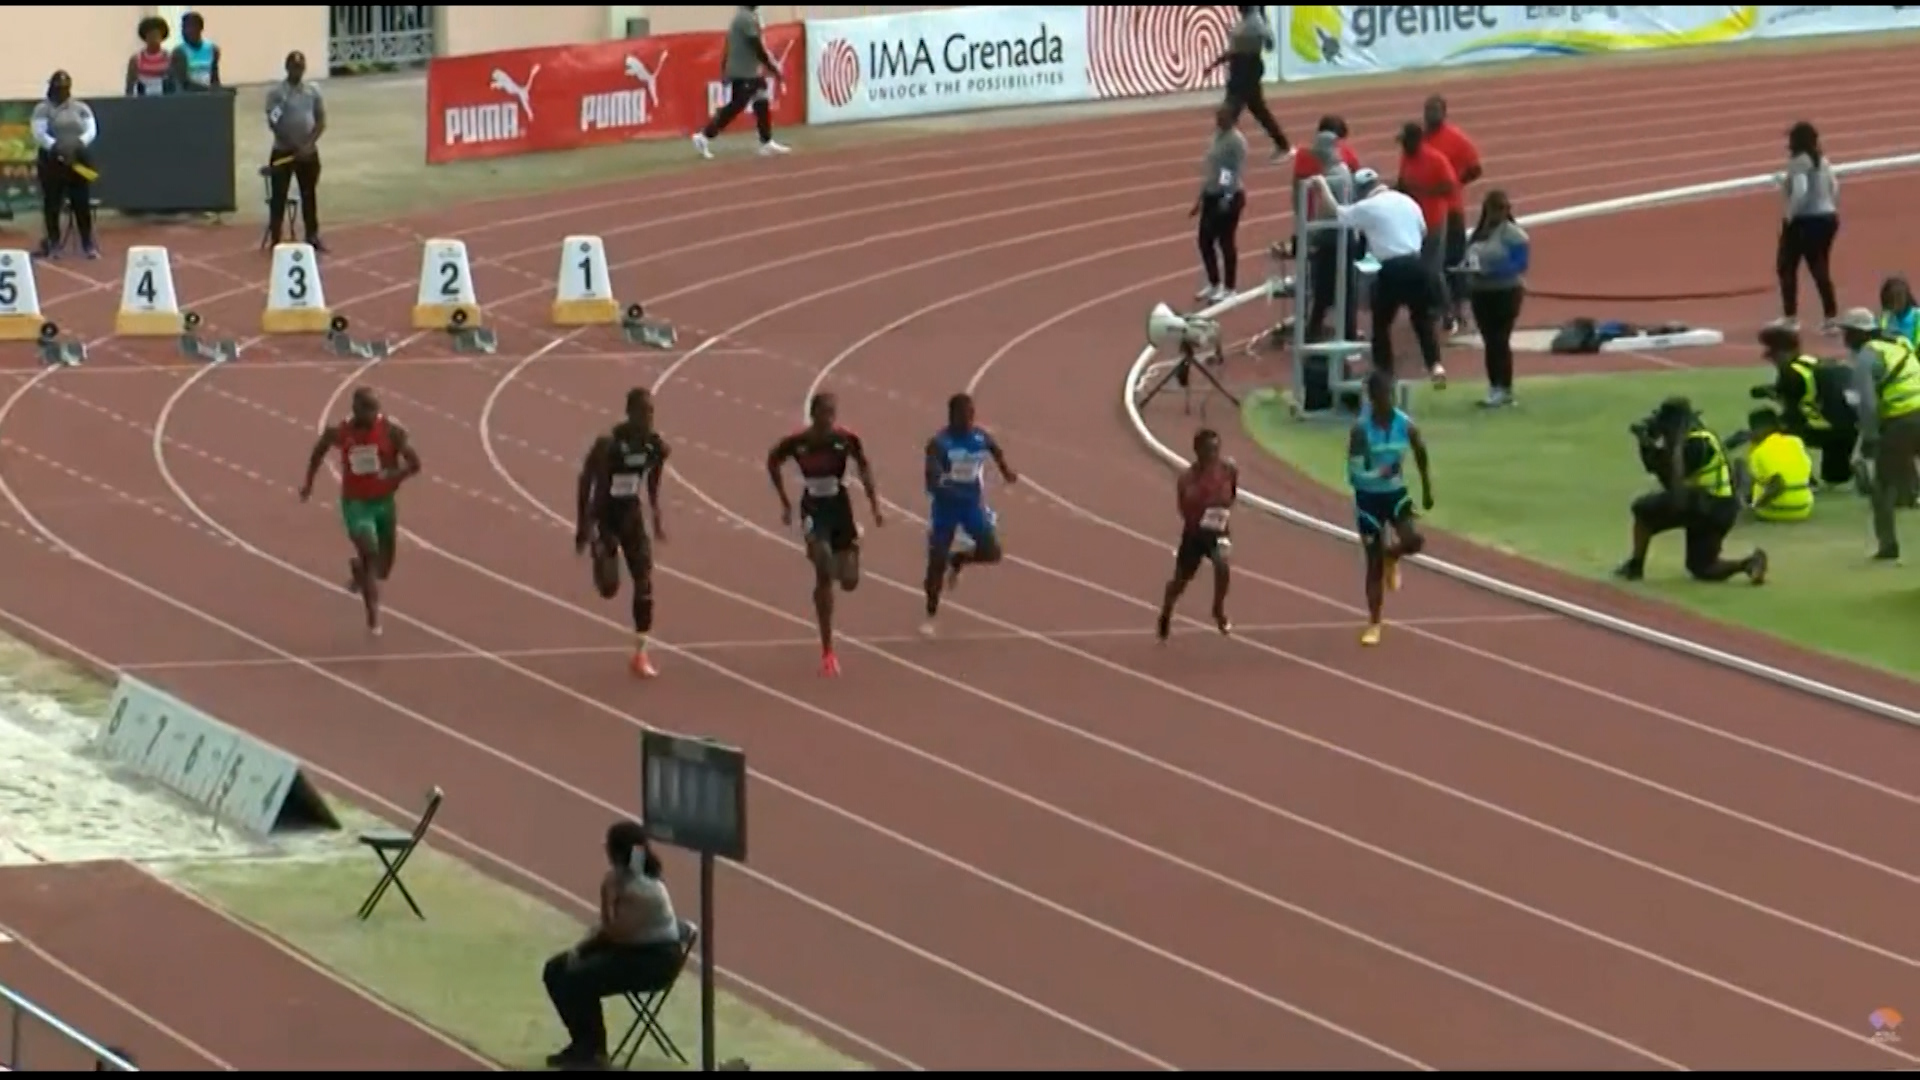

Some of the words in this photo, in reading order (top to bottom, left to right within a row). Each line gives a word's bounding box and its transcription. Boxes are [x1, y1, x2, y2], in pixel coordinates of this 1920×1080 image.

[869, 38, 935, 79] IMA
[943, 22, 1064, 73] Grenada
[869, 83, 928, 101] UNLOCK
[935, 80, 961, 95] THE
[967, 71, 1064, 92] POSSIBILITIES
[445, 102, 519, 146] PUMA
[581, 87, 646, 132] PUMA
[0, 271, 18, 305] 5
[136, 269, 157, 303] 4
[287, 265, 308, 301] 3
[439, 262, 460, 296] 2
[578, 256, 593, 291] 1
